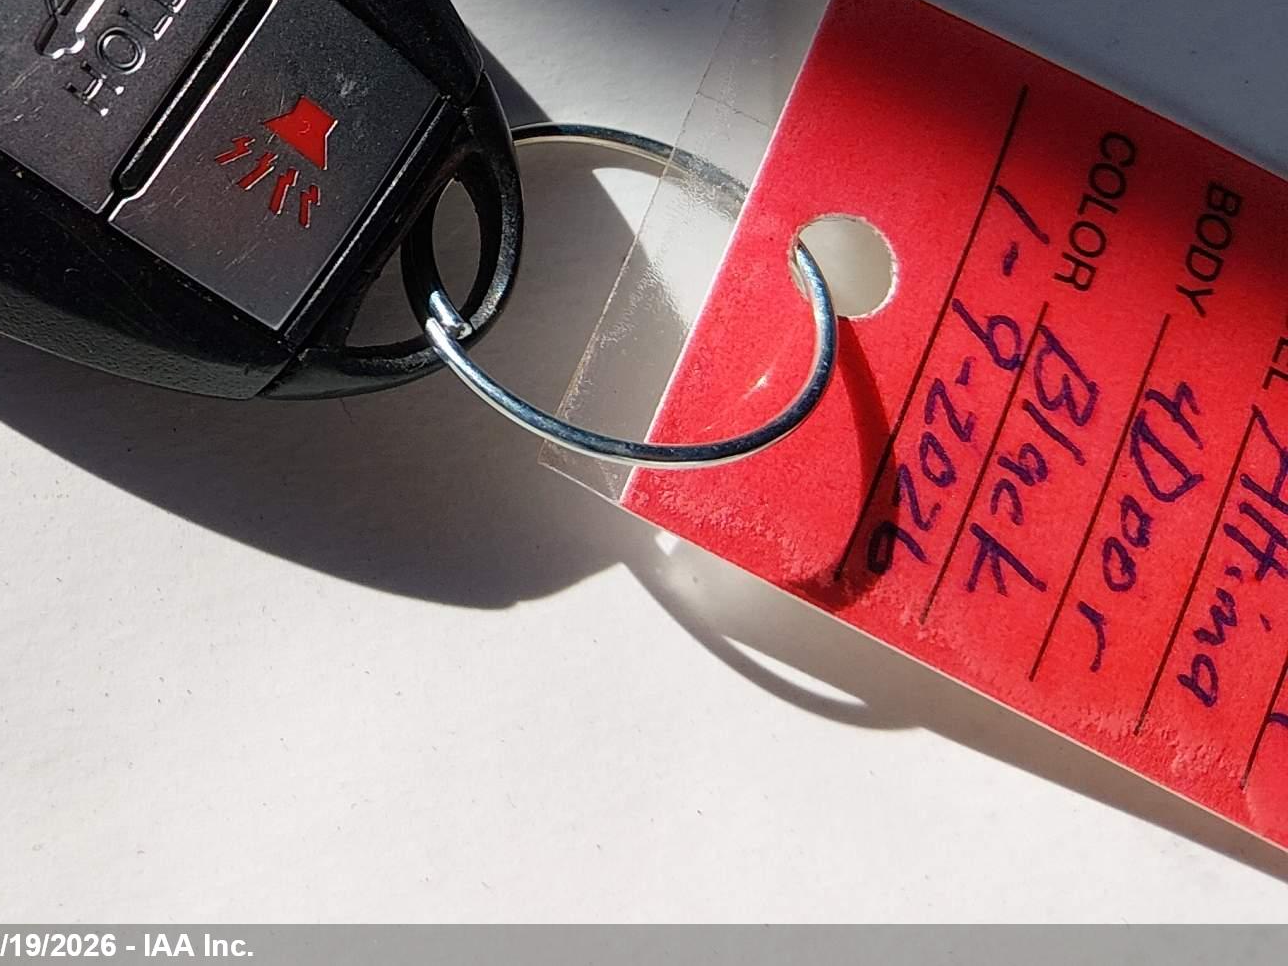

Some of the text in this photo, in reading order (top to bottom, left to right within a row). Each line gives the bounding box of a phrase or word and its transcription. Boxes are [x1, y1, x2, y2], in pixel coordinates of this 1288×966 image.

[1052, 131, 1137, 292] COLOR
[1175, 180, 1244, 319] BODY
[965, 324, 1100, 596] Black
